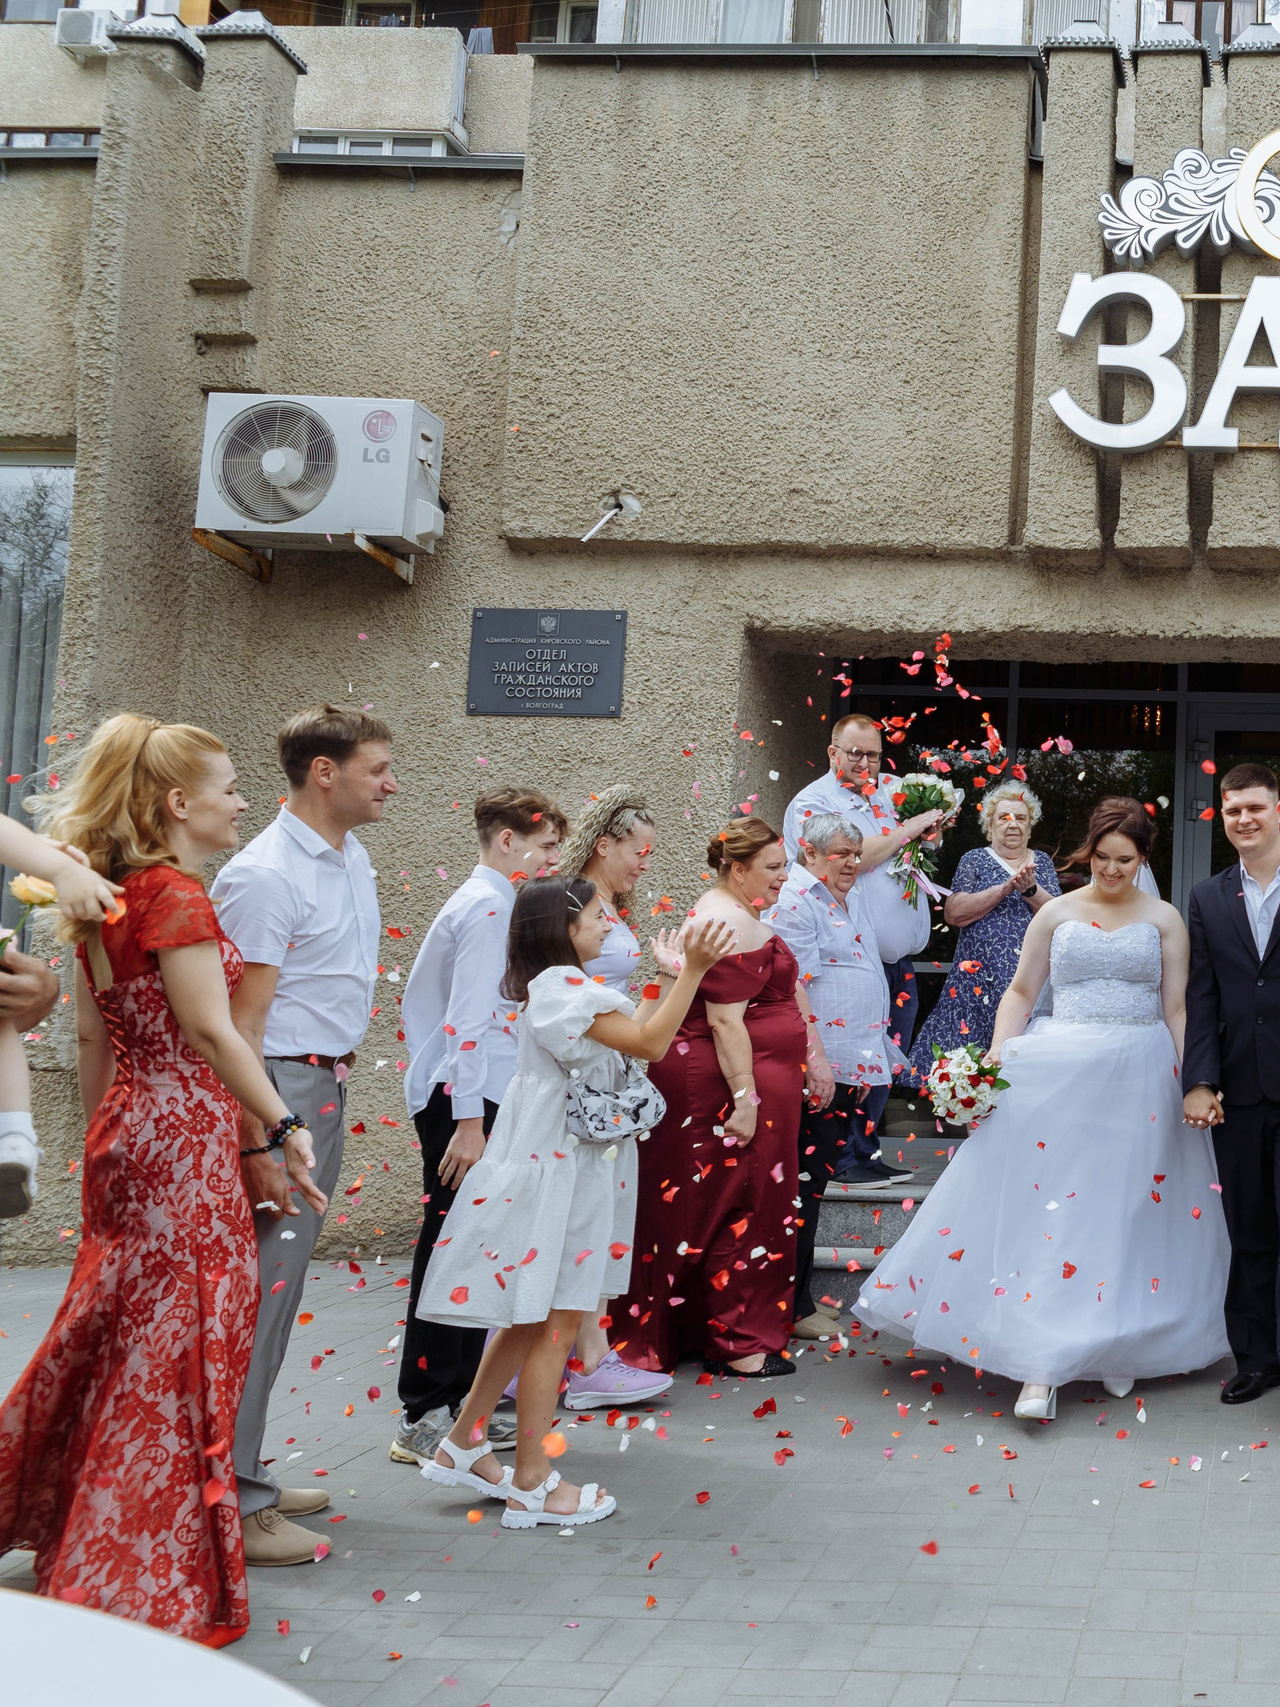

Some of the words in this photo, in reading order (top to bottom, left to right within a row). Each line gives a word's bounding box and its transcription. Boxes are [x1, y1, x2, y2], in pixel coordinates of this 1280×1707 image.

[362, 447, 391, 463] LG
[525, 649, 567, 660] ОТДЕЛ
[492, 661, 551, 672] ЗАПИСЕЙ
[558, 662, 599, 674] АКТОВ
[494, 674, 594, 686] ГРАЖДАНСКОГО
[505, 687, 582, 699] СОСТОЯНИЯ
